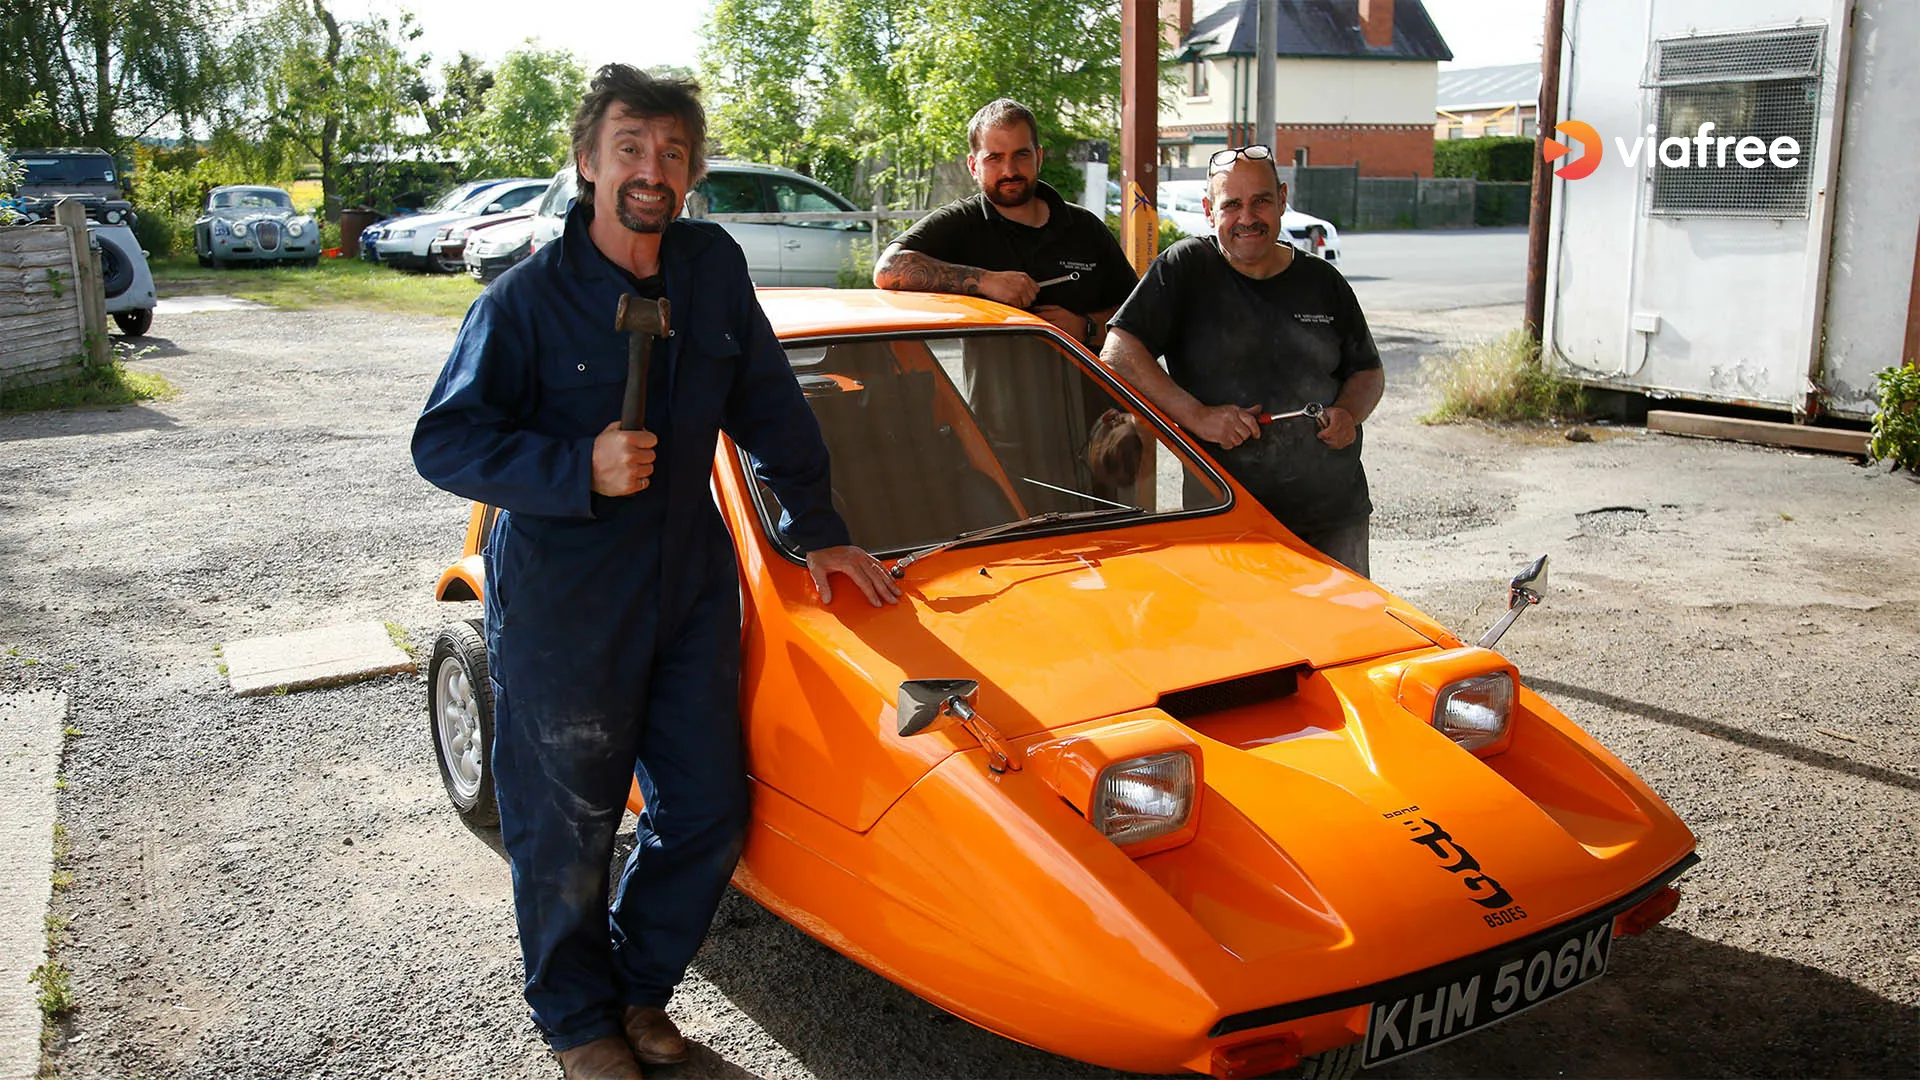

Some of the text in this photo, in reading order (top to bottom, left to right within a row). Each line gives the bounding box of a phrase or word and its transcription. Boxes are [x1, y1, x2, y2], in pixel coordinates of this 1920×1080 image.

[1483, 905, 1528, 928] 850ES
[1370, 923, 1609, 1059] KHM 506K
